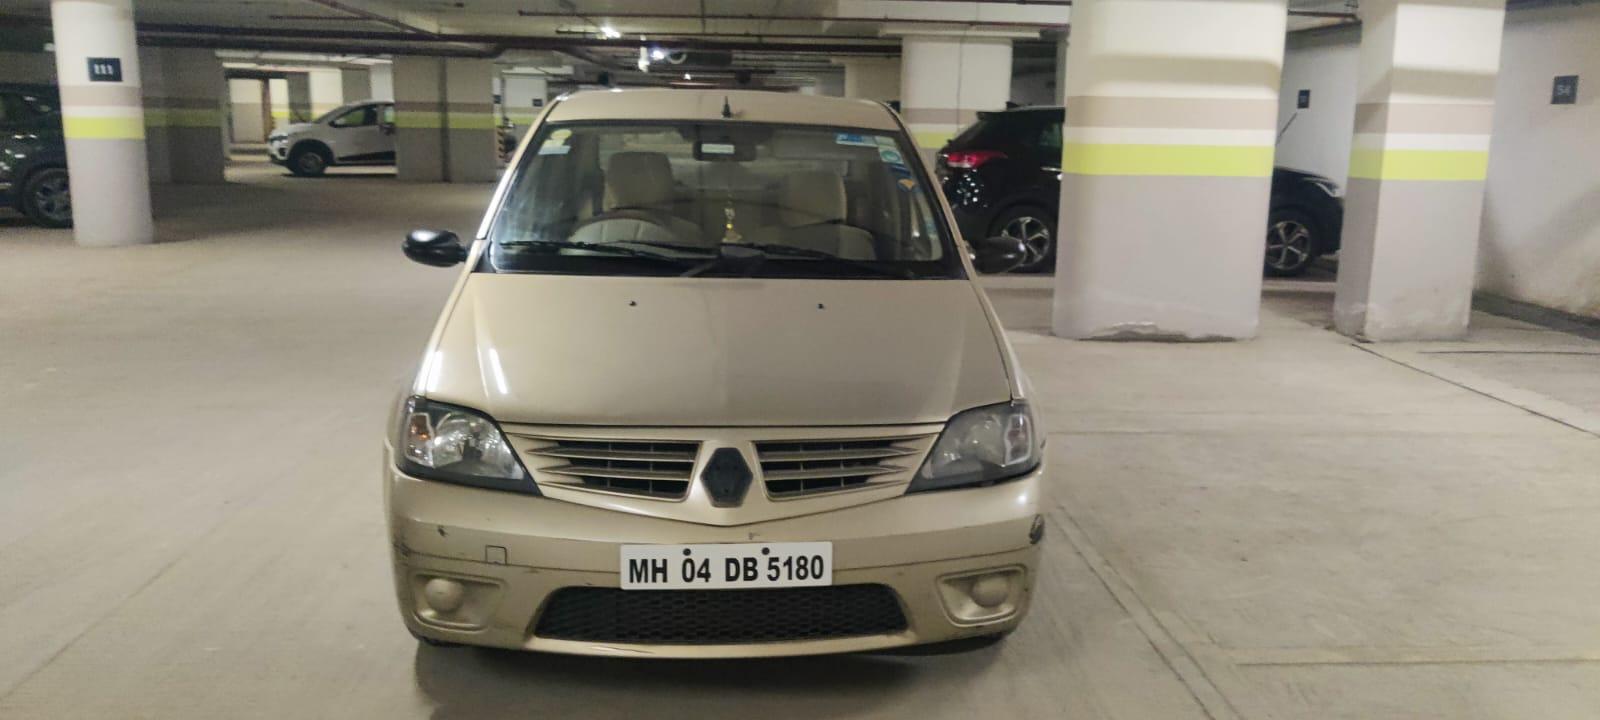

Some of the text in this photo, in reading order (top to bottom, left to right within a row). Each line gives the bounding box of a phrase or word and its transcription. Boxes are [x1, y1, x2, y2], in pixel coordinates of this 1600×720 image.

[94, 63, 113, 74] 111
[629, 554, 824, 583] MH 04 DB 5180
